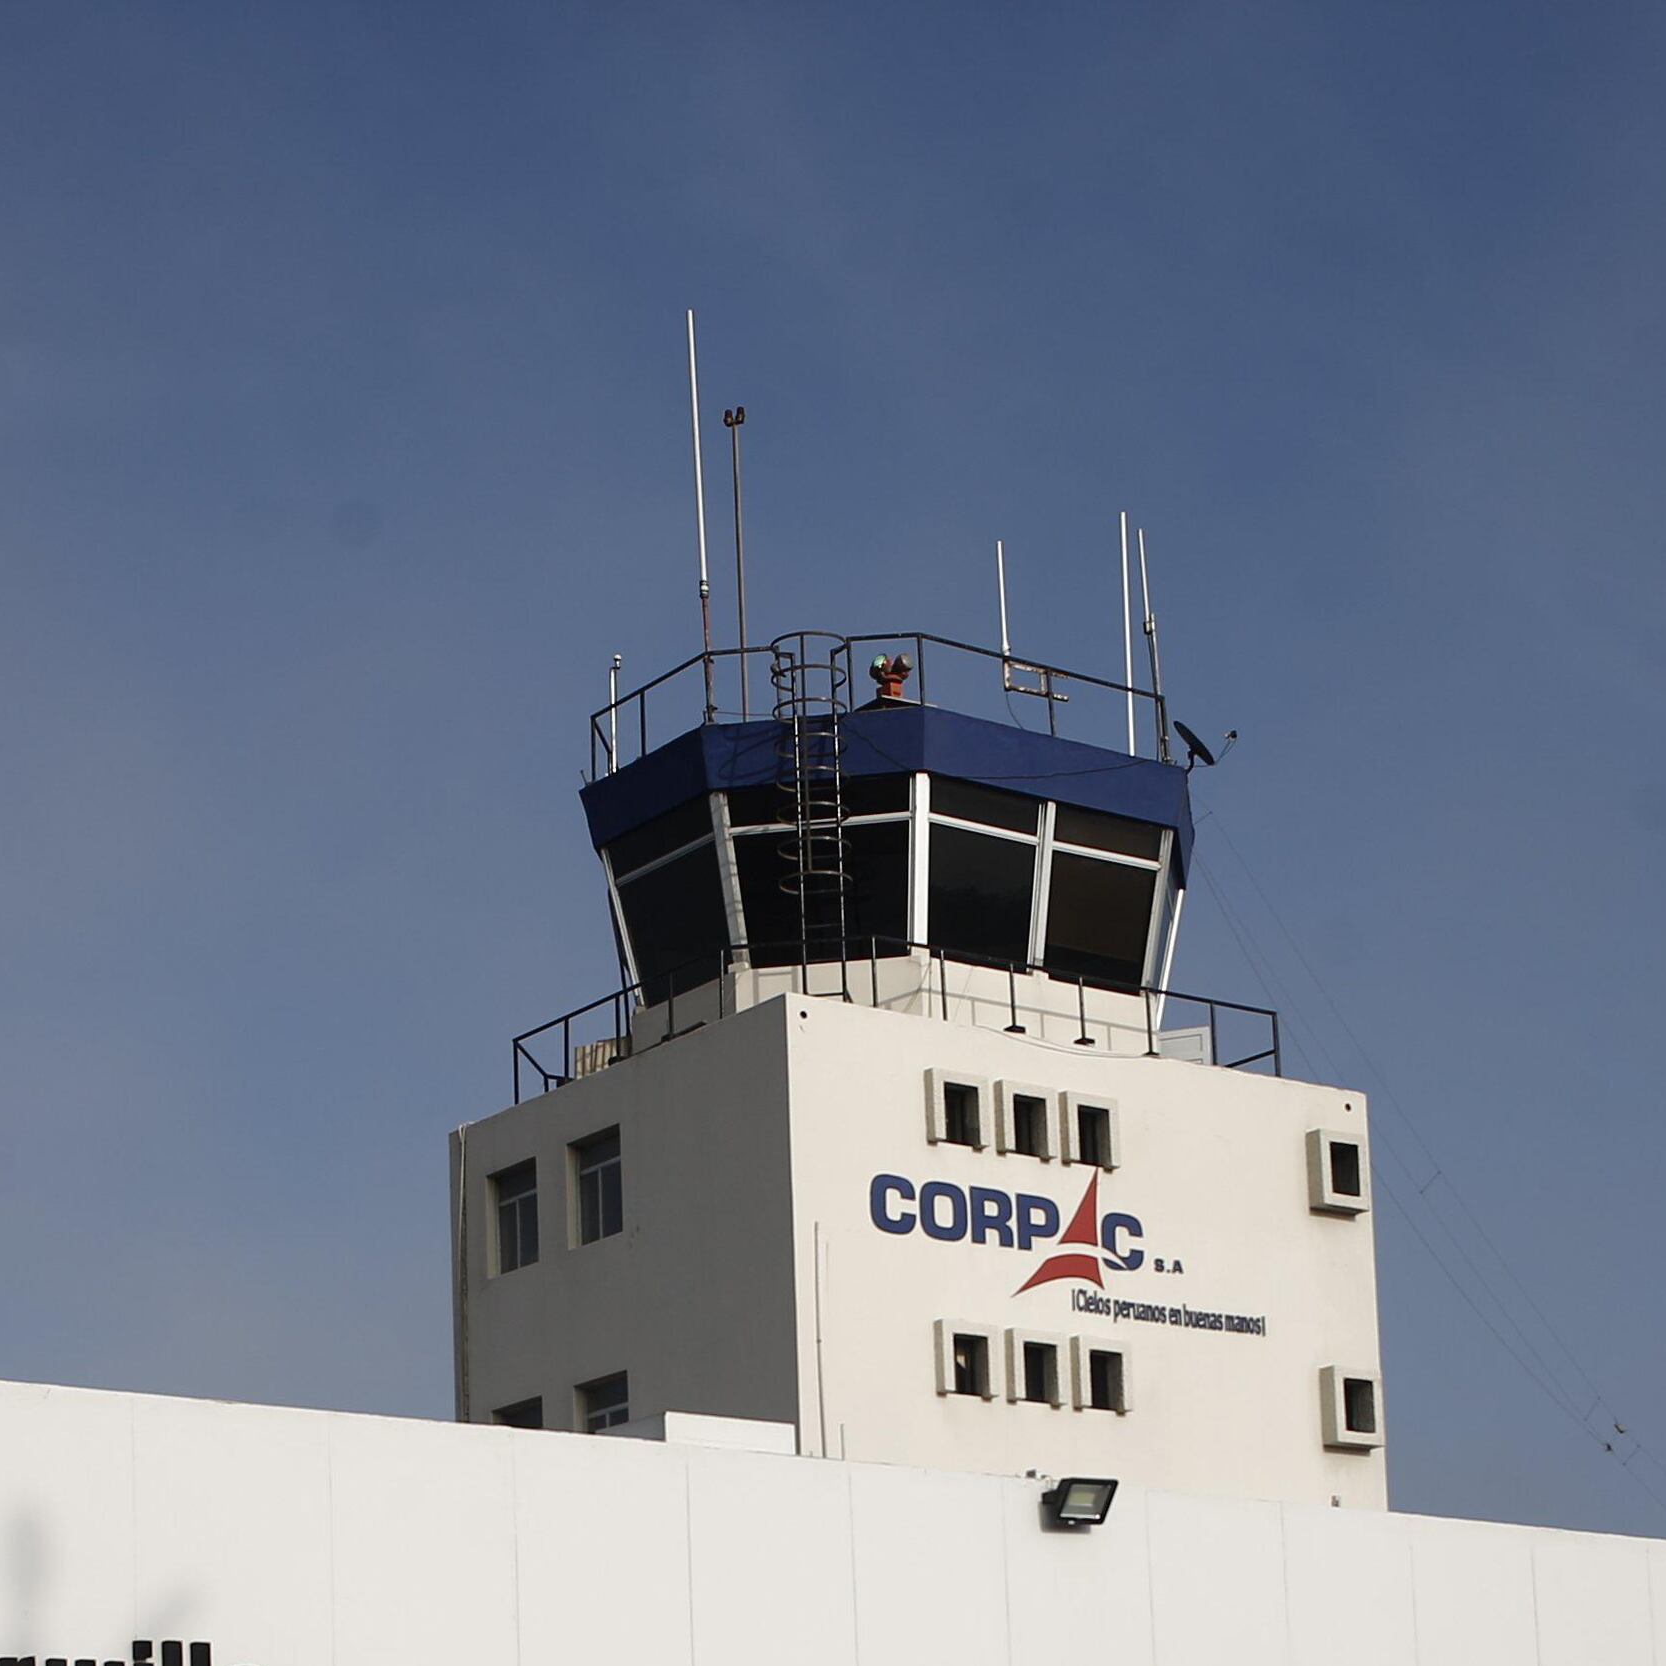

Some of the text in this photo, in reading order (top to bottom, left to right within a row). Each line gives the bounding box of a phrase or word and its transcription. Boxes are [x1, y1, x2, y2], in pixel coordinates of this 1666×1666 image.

[869, 1167, 1145, 1298] CORPAC
[1113, 1297, 1167, 1323] peruanos
[1168, 1306, 1182, 1326] en
[1182, 1303, 1224, 1331] buenas
